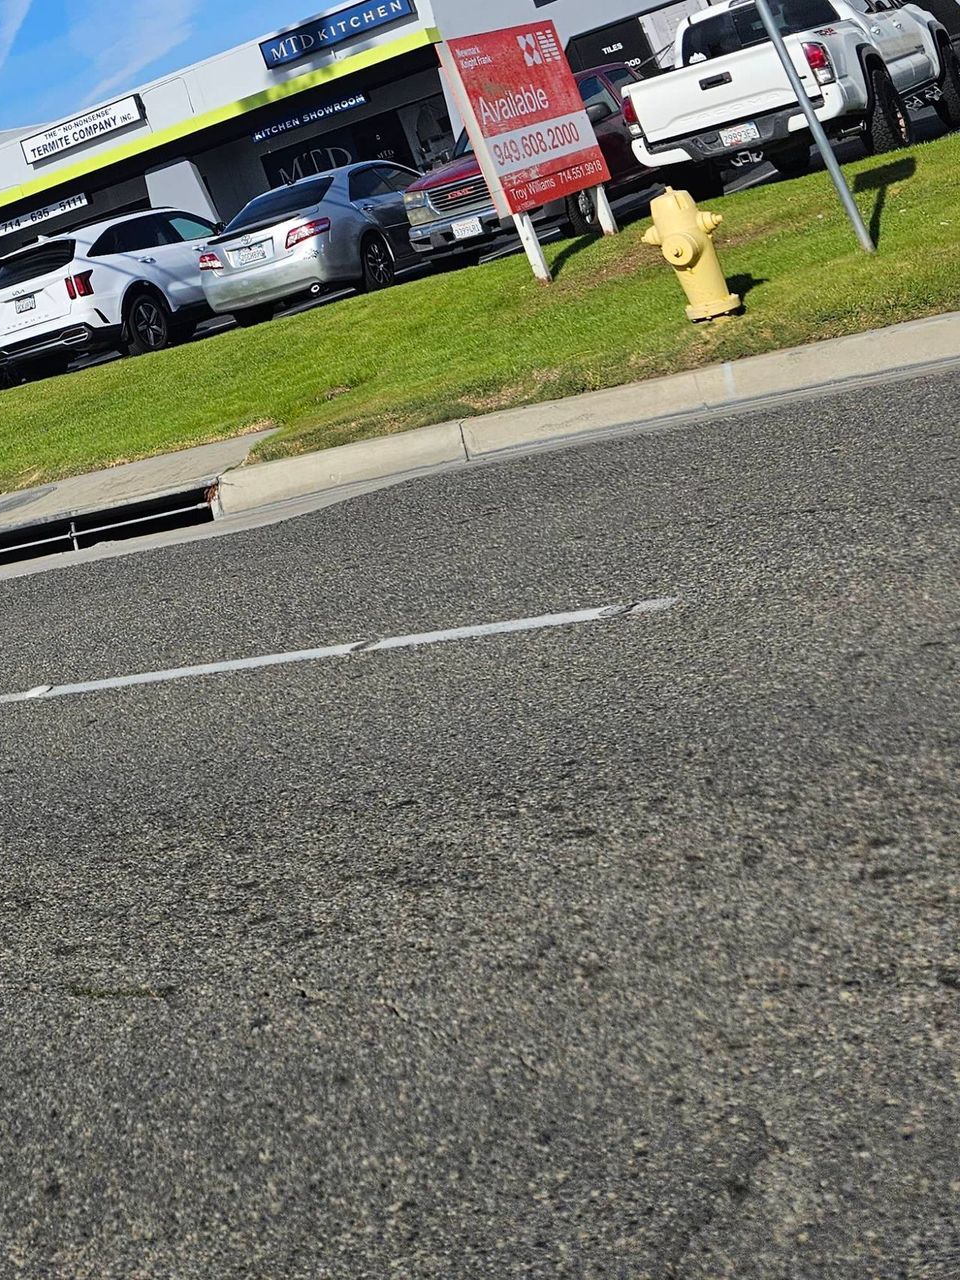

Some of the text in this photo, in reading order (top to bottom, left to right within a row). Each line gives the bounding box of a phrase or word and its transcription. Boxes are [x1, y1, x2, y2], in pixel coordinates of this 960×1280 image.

[271, 0, 402, 61] MTD KITCHEN
[602, 43, 623, 55] TILES
[455, 47, 480, 58] Newmark
[461, 55, 492, 70] Knight Frank
[254, 94, 366, 140] KITCHEN SHOWROOM
[478, 84, 549, 125] Available
[31, 113, 135, 158] TERMITE COMPANY INC.
[44, 130, 57, 140] THE
[493, 121, 580, 166] 949.608.2000
[510, 188, 528, 201] Troy
[528, 177, 556, 196] Williams
[1, 219, 21, 233] 714
[30, 207, 50, 222] 635
[60, 196, 83, 212] 5111
